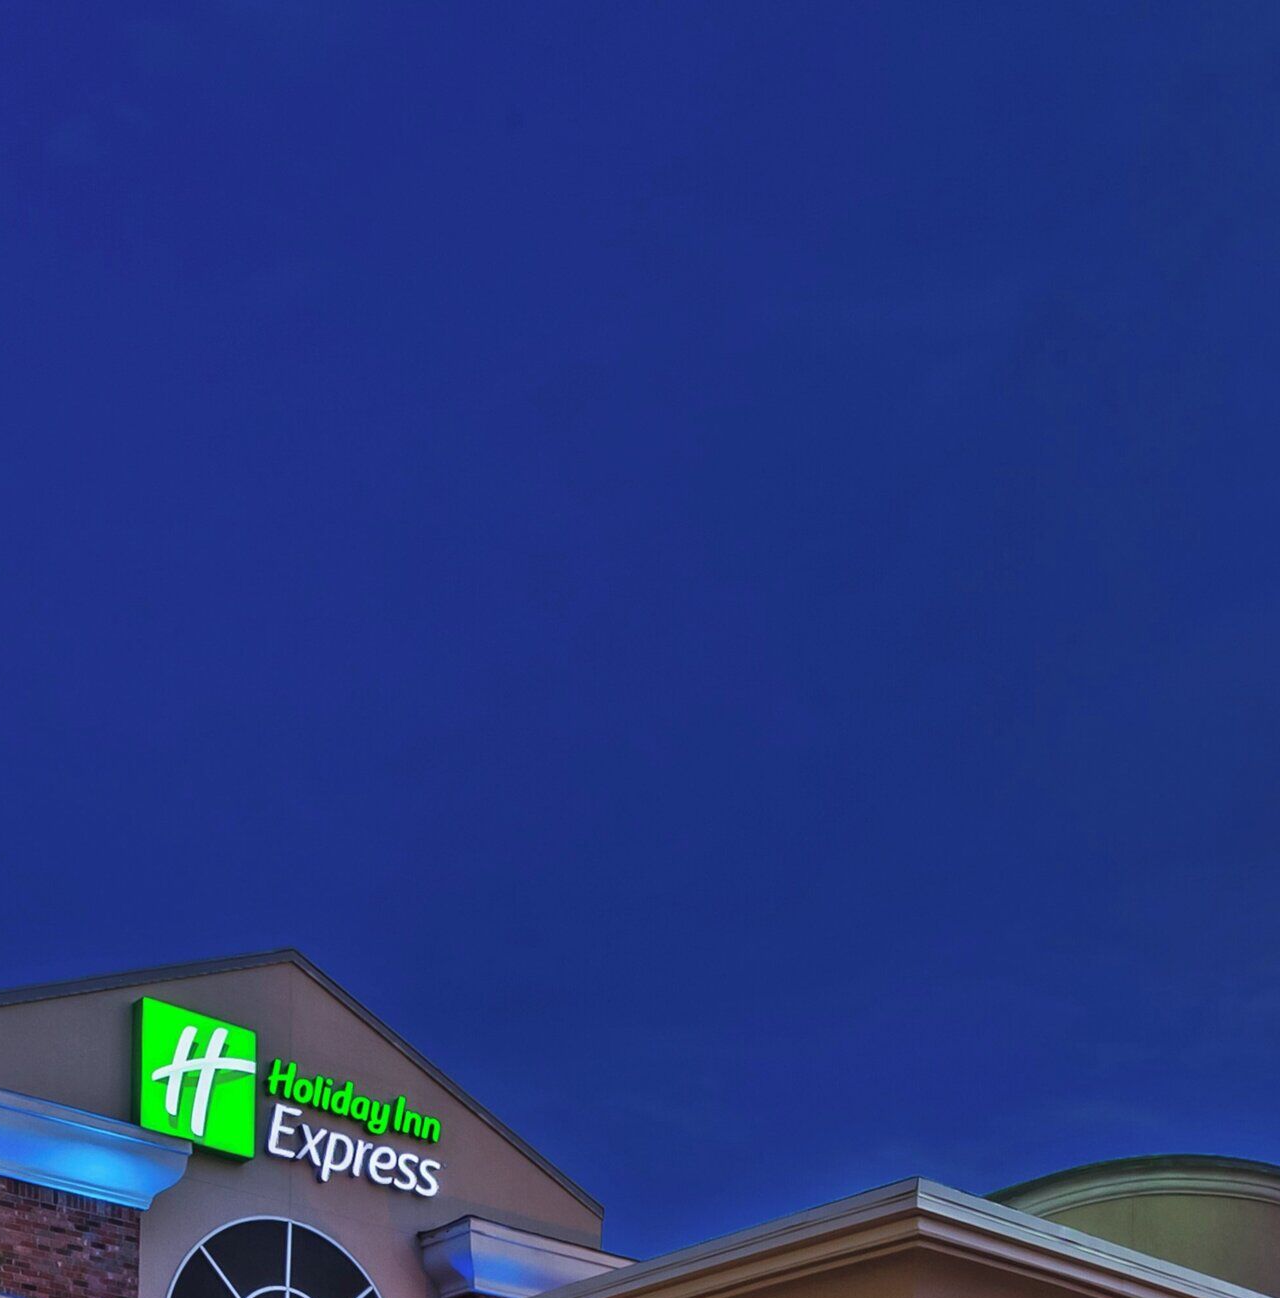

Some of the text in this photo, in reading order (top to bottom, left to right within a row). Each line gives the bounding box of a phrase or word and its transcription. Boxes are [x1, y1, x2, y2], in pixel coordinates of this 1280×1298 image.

[266, 1057, 442, 1143] Holiday Inn
[266, 1102, 442, 1198] Express
